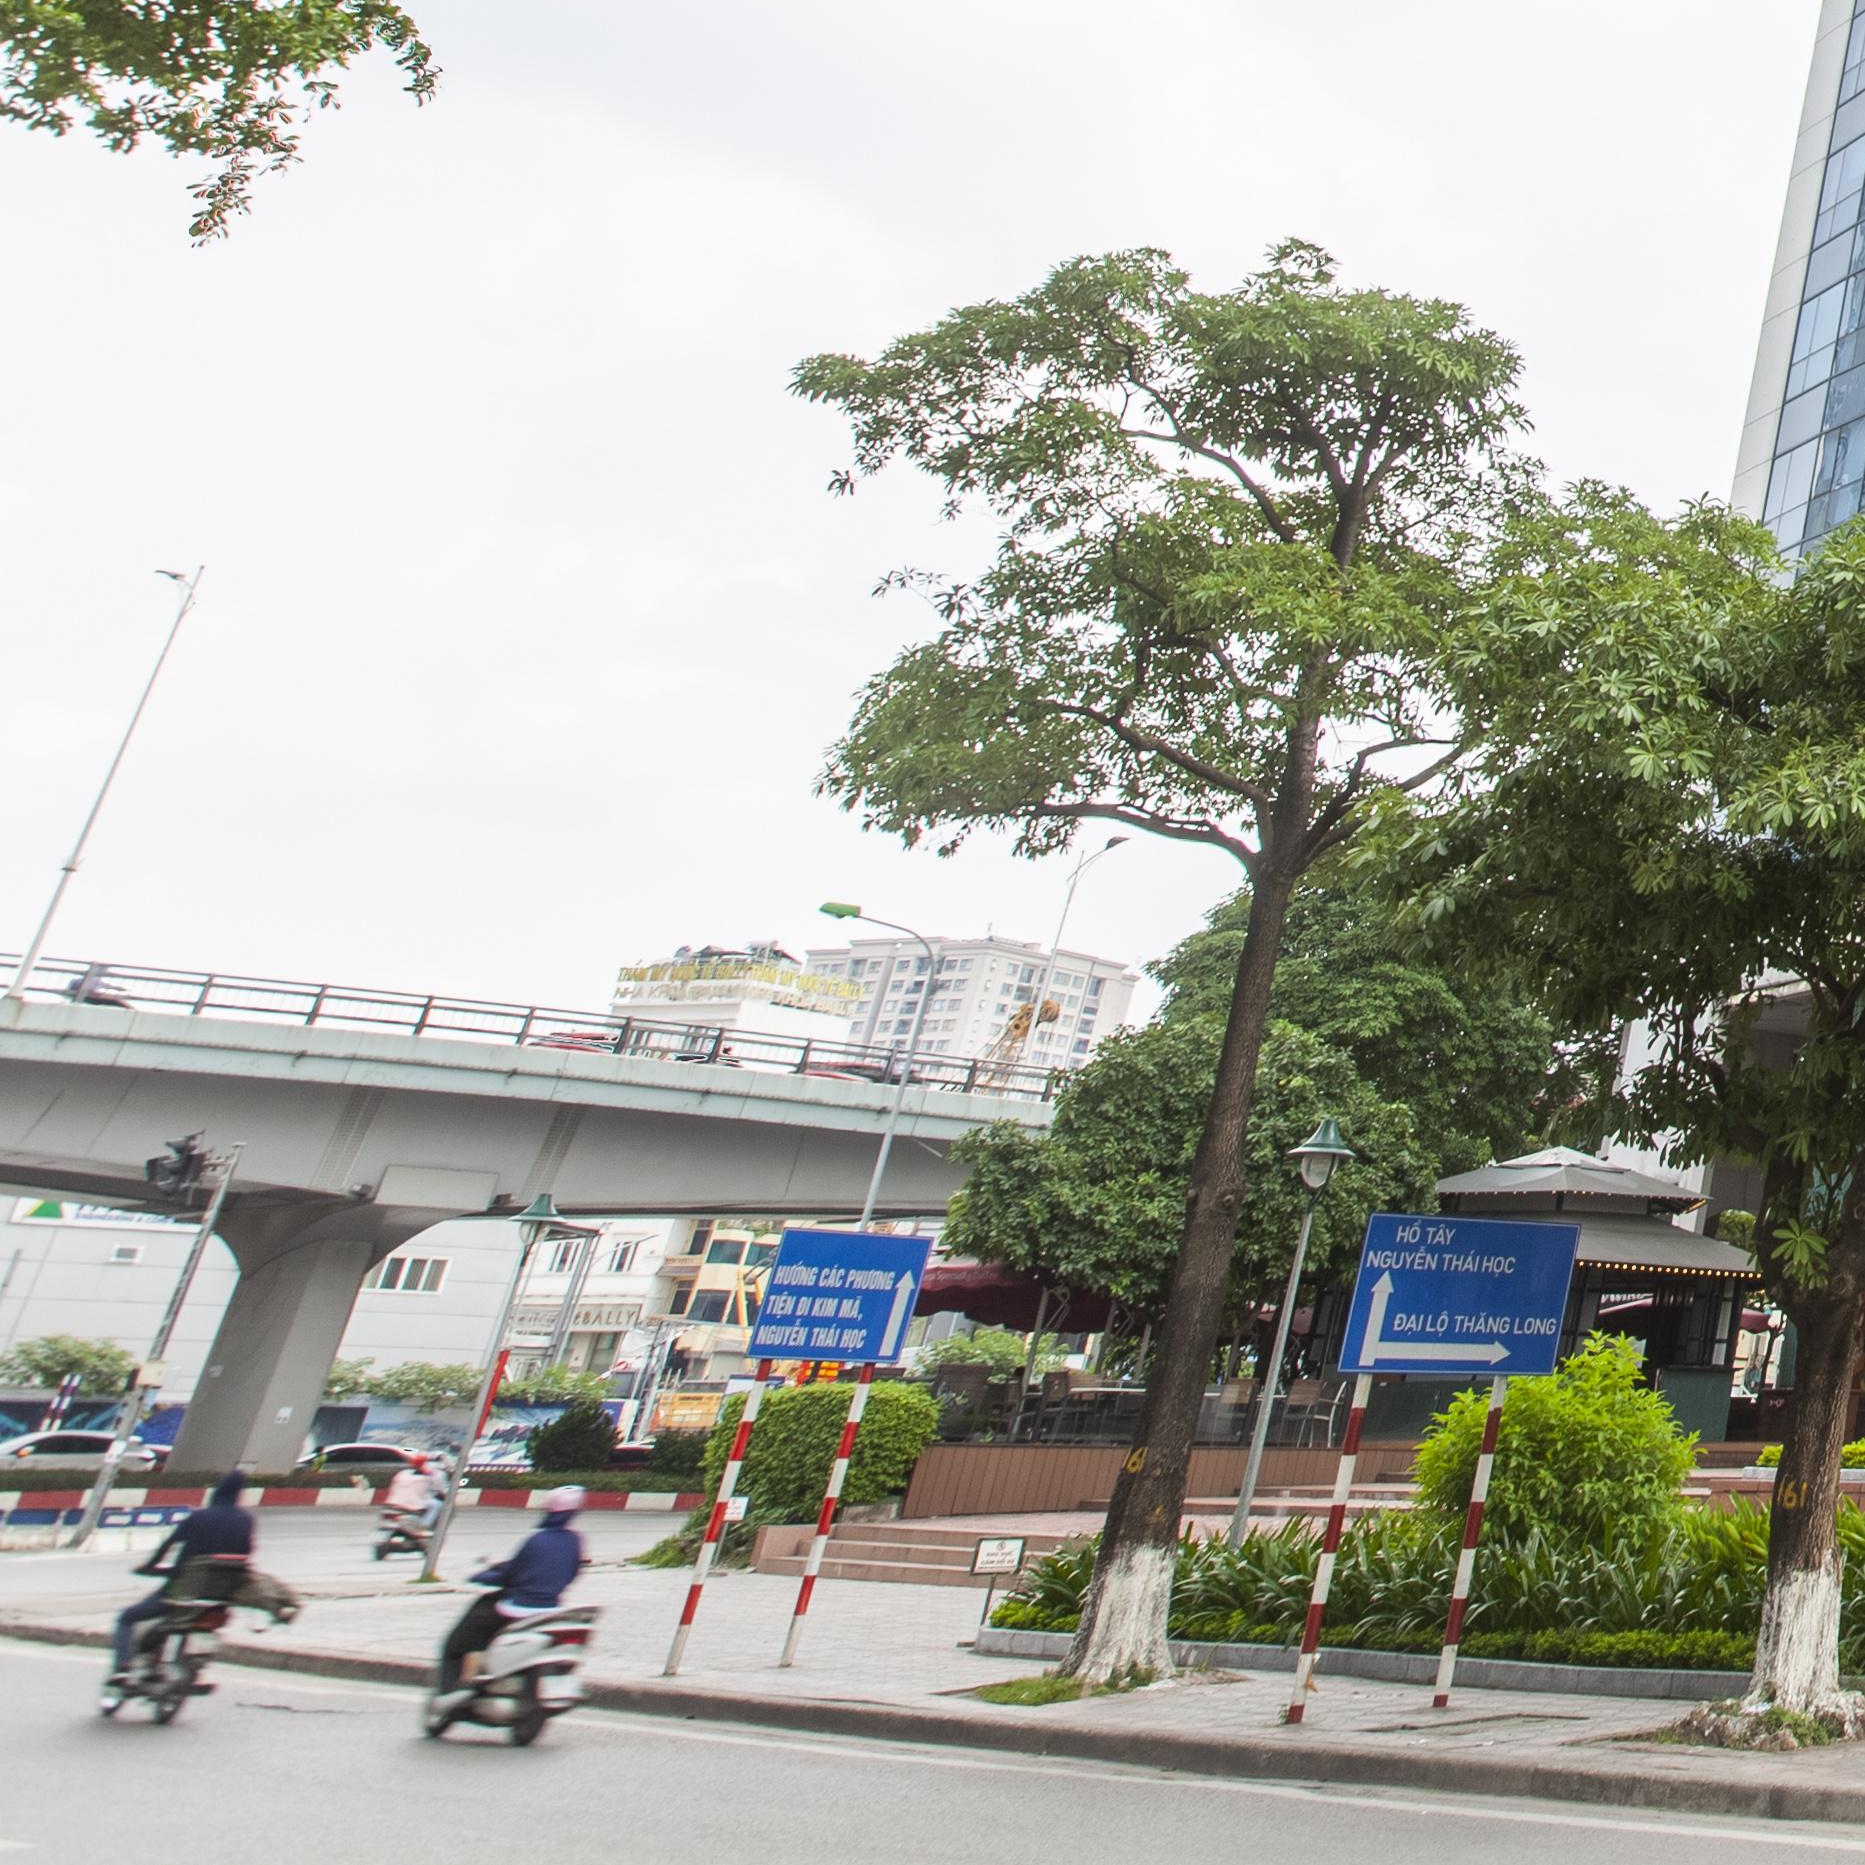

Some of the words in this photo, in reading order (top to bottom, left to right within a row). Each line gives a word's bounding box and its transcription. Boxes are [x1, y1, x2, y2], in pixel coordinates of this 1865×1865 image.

[1426, 1223, 1457, 1246] TÂY
[1366, 1246, 1439, 1271] NGUYỄN
[1442, 1249, 1480, 1273] THÁI
[1481, 1255, 1517, 1278] HỌC
[819, 1264, 846, 1289] CÁC
[844, 1268, 896, 1291] PHƯƠNG
[766, 1292, 797, 1320] TIỆN
[796, 1297, 813, 1318] ĐI
[811, 1297, 839, 1318] KIM
[755, 1318, 808, 1347] NGUYỄN
[809, 1322, 841, 1348] THÁI
[839, 1328, 868, 1353] HỌC
[1392, 1312, 1424, 1336] ĐẠI
[1425, 1310, 1449, 1337] LỘ
[1453, 1311, 1511, 1334] THĂNG
[1512, 1317, 1558, 1336] LONG
[1777, 1472, 1808, 1510] 161
